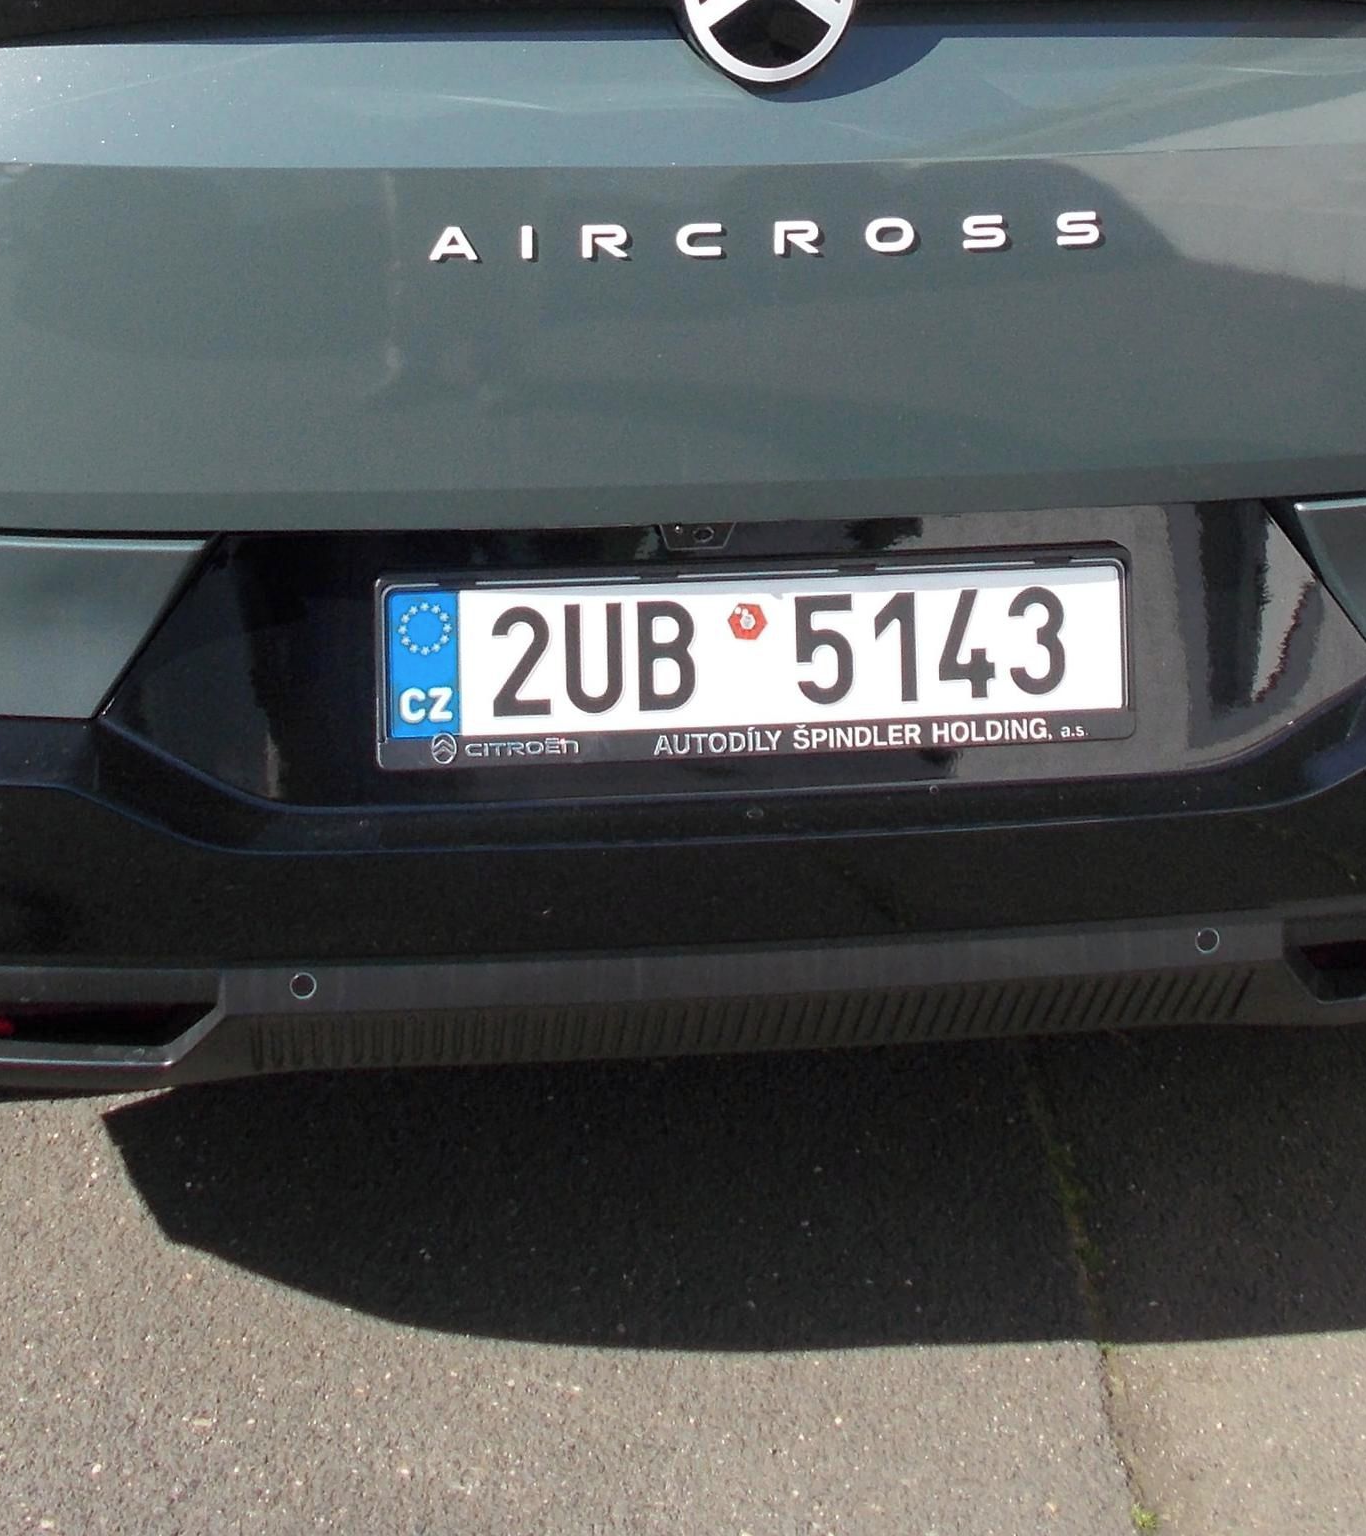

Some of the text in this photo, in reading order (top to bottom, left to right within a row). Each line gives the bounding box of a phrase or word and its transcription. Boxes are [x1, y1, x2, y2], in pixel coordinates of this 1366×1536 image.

[429, 210, 1103, 262] AIRCROSS
[491, 586, 1067, 718] 2UB 5143
[400, 687, 453, 724] CZ
[653, 717, 1089, 756] AUTODÍLY ŠPINDLER HOLDING, a.s.
